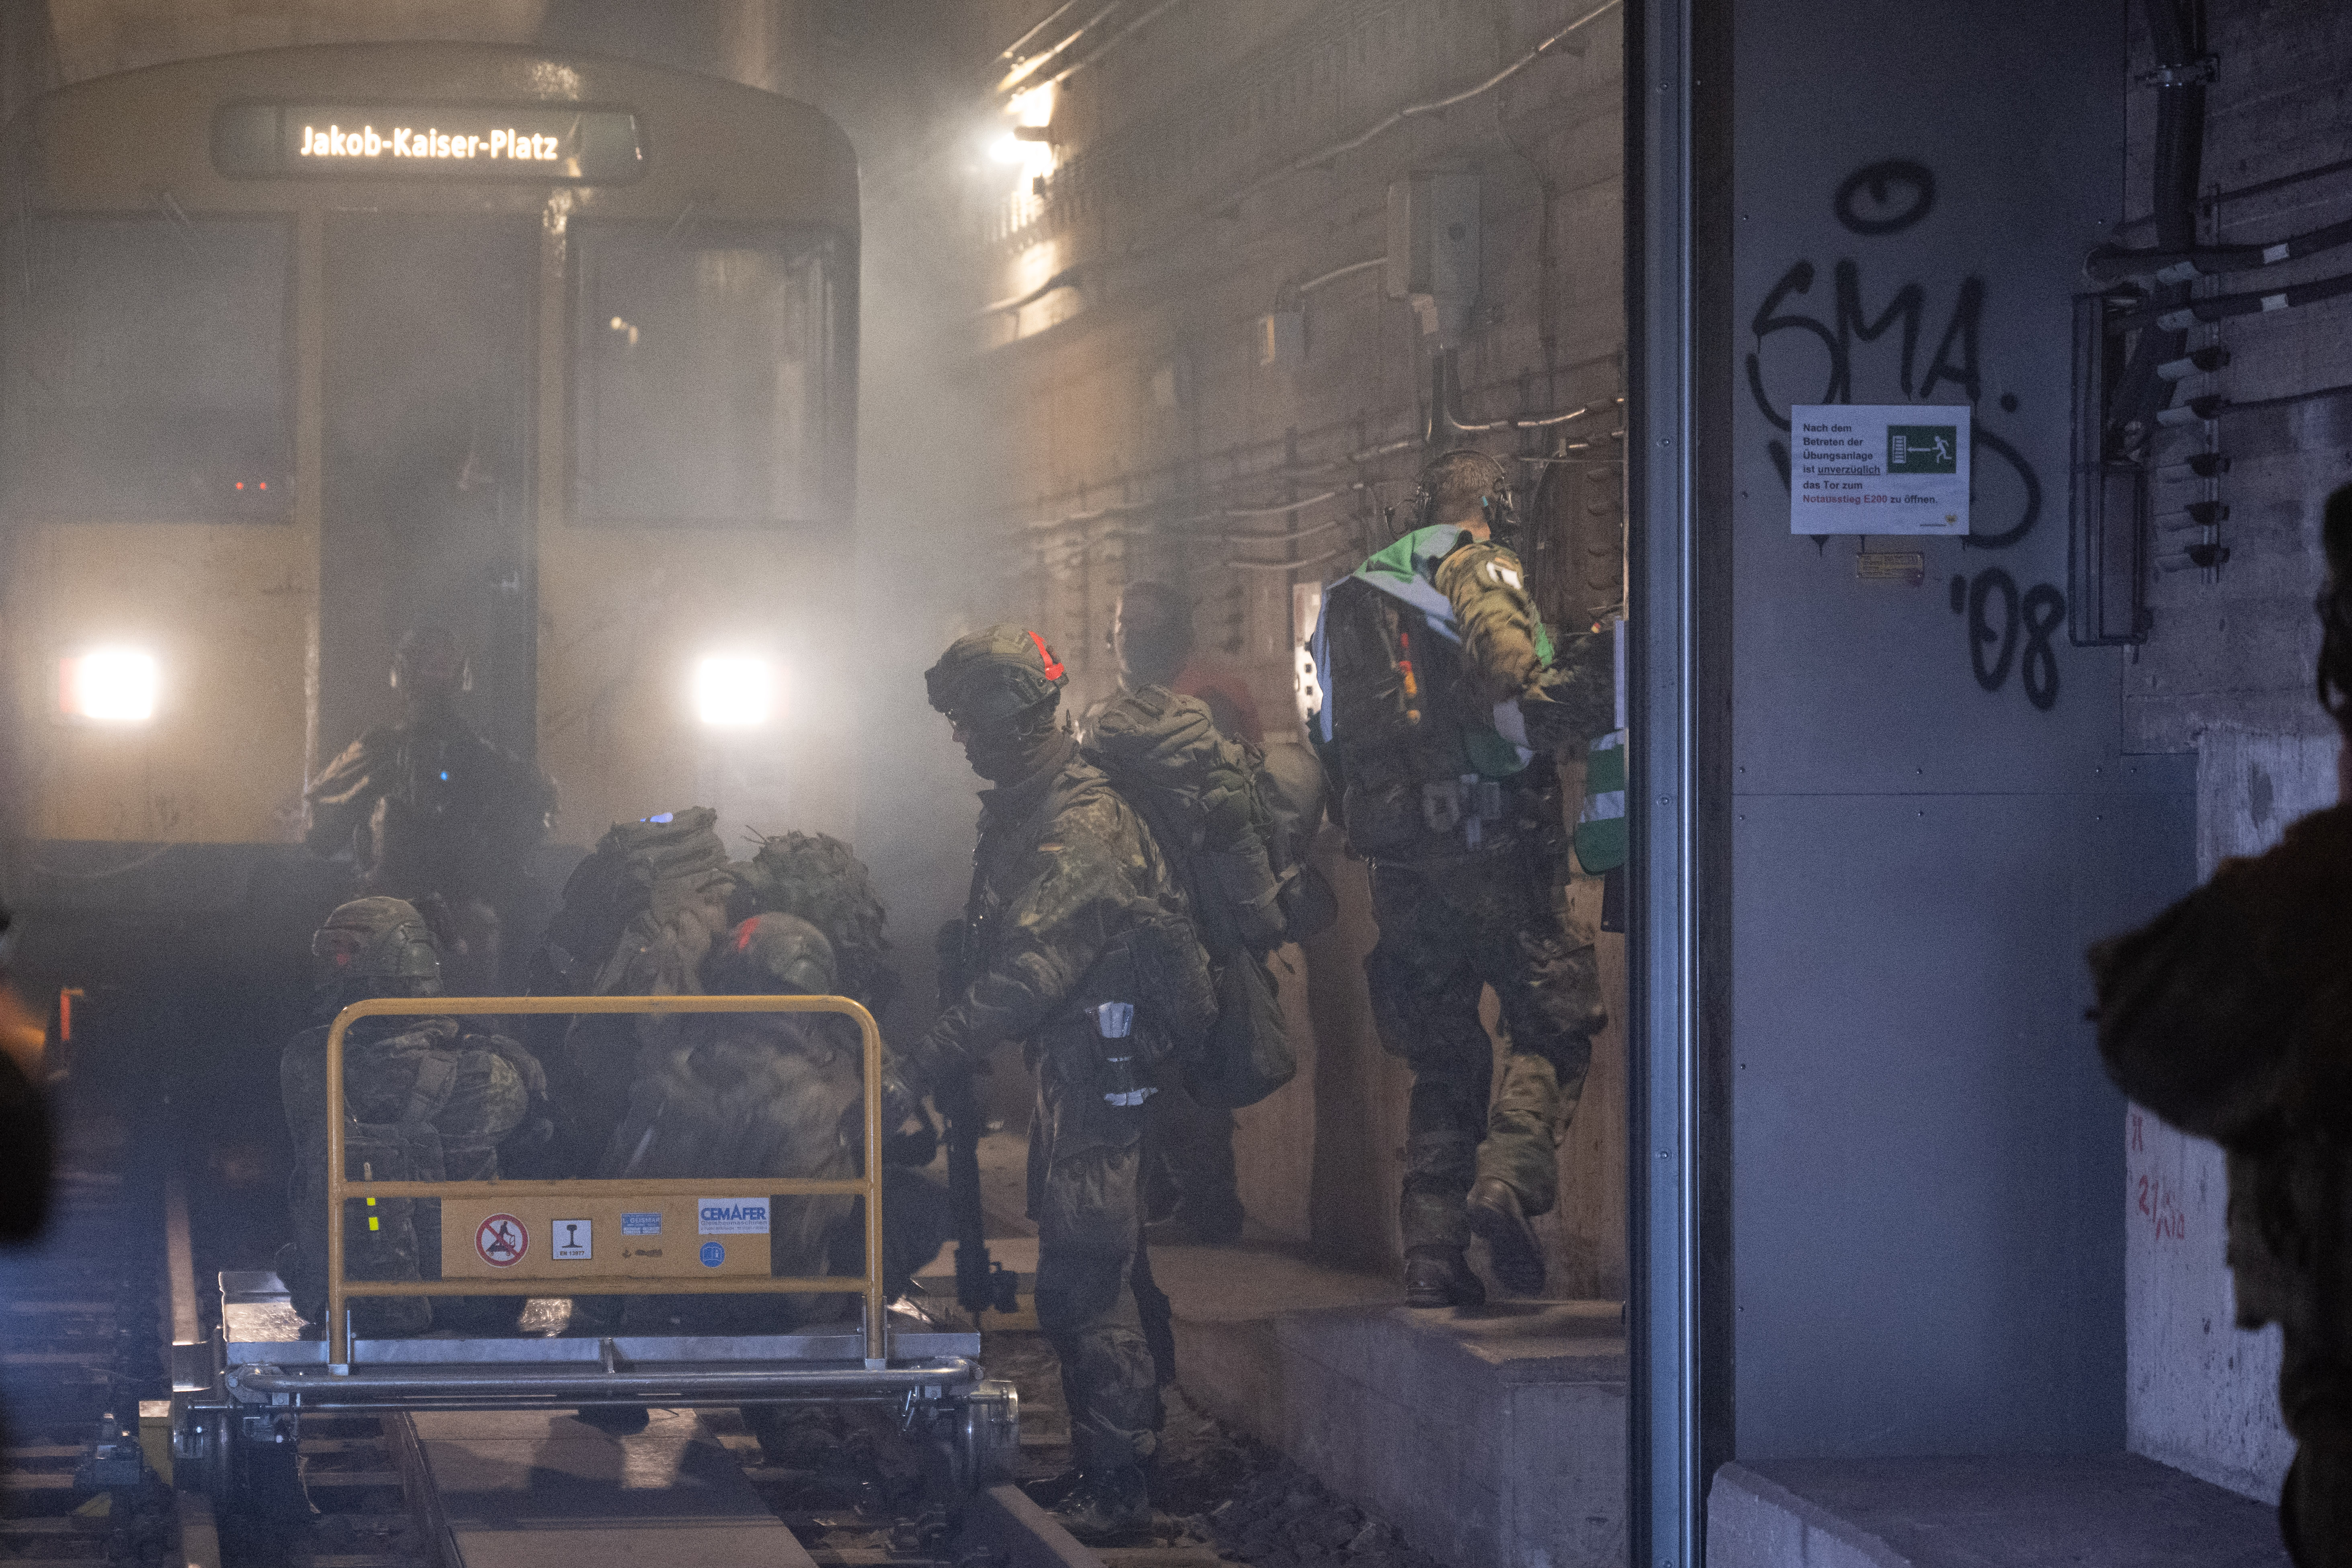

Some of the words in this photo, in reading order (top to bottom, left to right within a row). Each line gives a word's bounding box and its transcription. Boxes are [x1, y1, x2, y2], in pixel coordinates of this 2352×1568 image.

[301, 125, 558, 160] Jakob-Kaiser-Platz
[1803, 424, 1828, 432] Nach
[1803, 437, 1844, 446] Betreten
[1848, 437, 1863, 446] der
[1803, 449, 1873, 461] Übungsanlage
[1818, 465, 1880, 475] unverzüglich
[1803, 481, 1820, 489] das
[1823, 481, 1840, 489] Tor
[1803, 495, 1861, 504] Notausstieg
[1864, 495, 1888, 503] E200
[1904, 495, 1938, 503] öffnen.
[701, 1203, 766, 1220] CEMAFER
